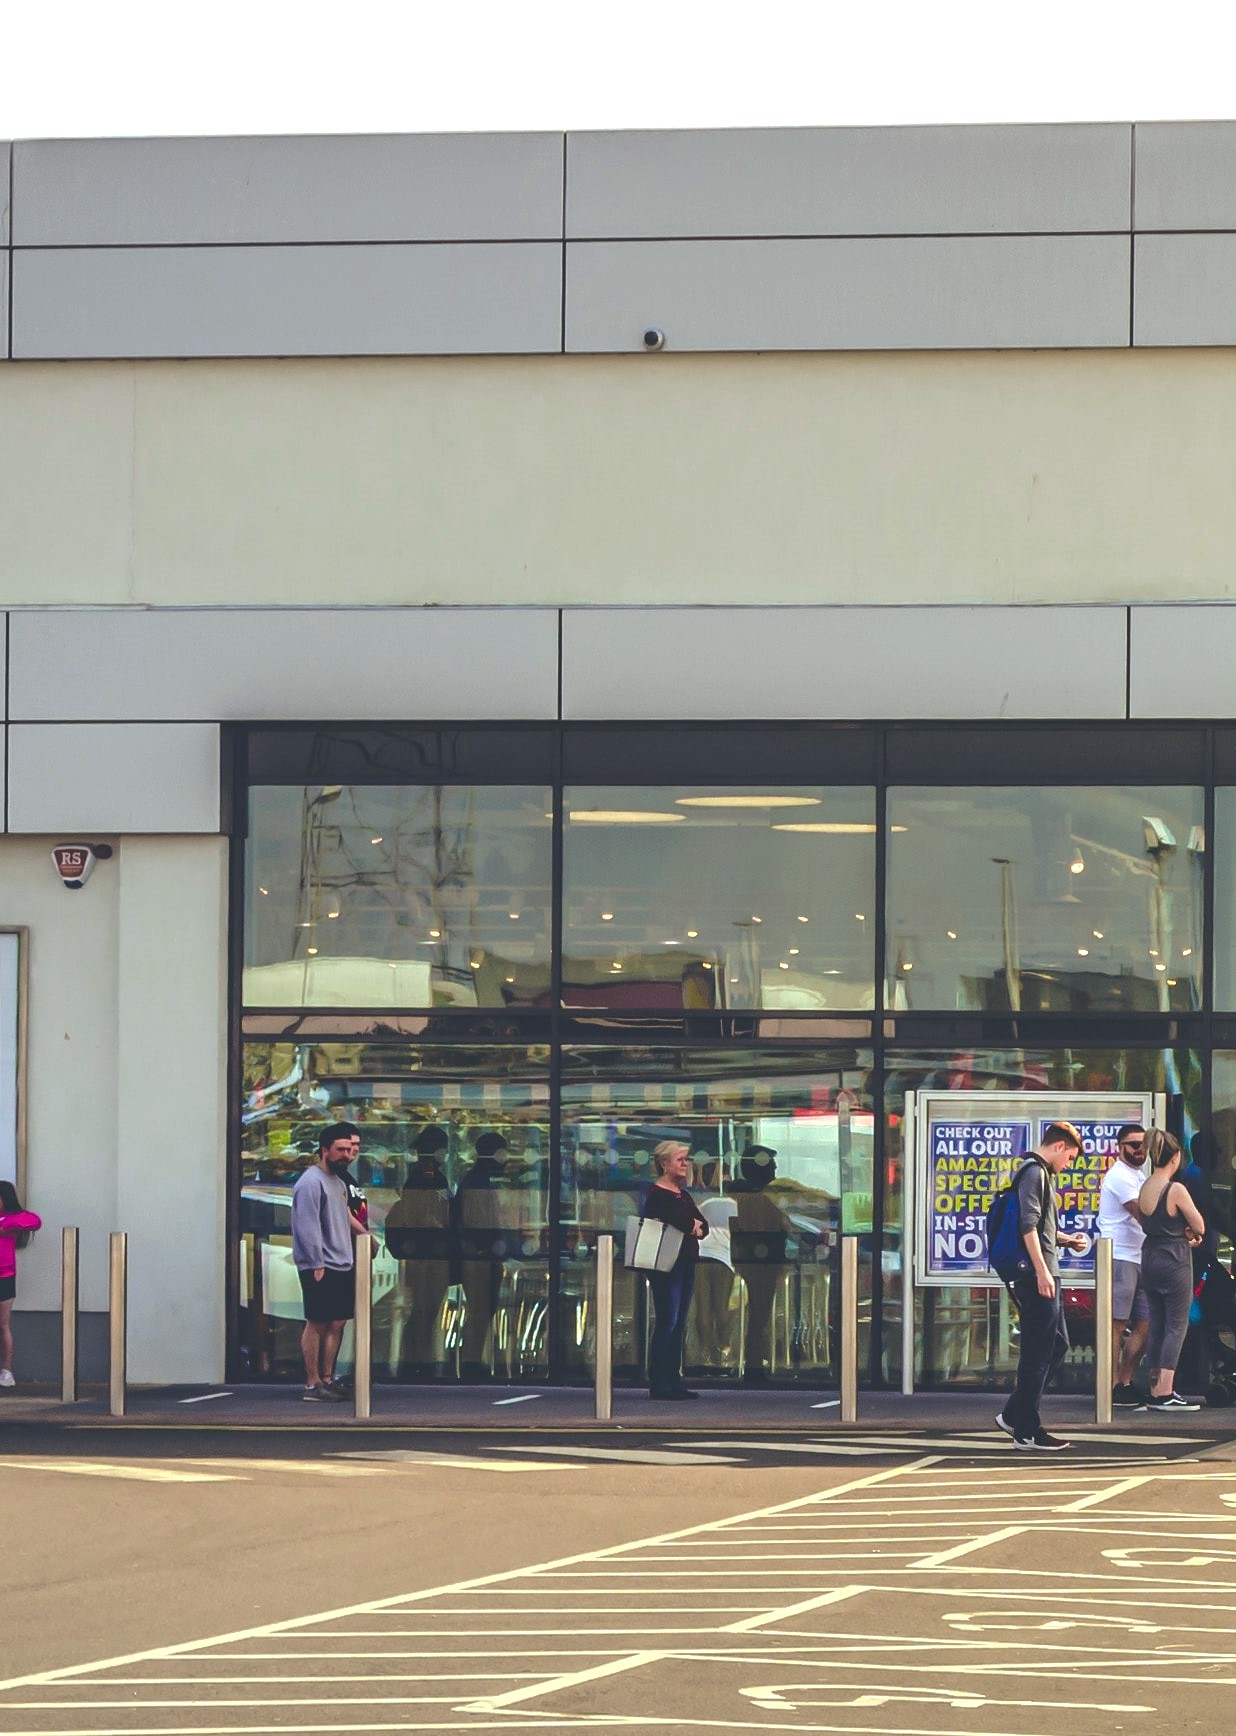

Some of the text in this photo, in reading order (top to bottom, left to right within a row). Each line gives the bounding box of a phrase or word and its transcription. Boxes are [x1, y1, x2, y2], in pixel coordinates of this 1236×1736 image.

[61, 852, 82, 865] RS
[936, 1127, 1013, 1139] CHECK OUT
[936, 1140, 1012, 1156] ALL OUR
[936, 1174, 1012, 1191] SPECIA
[935, 1194, 994, 1213] OFFE
[935, 1216, 987, 1231] IN-ST
[935, 1233, 988, 1258] NO
